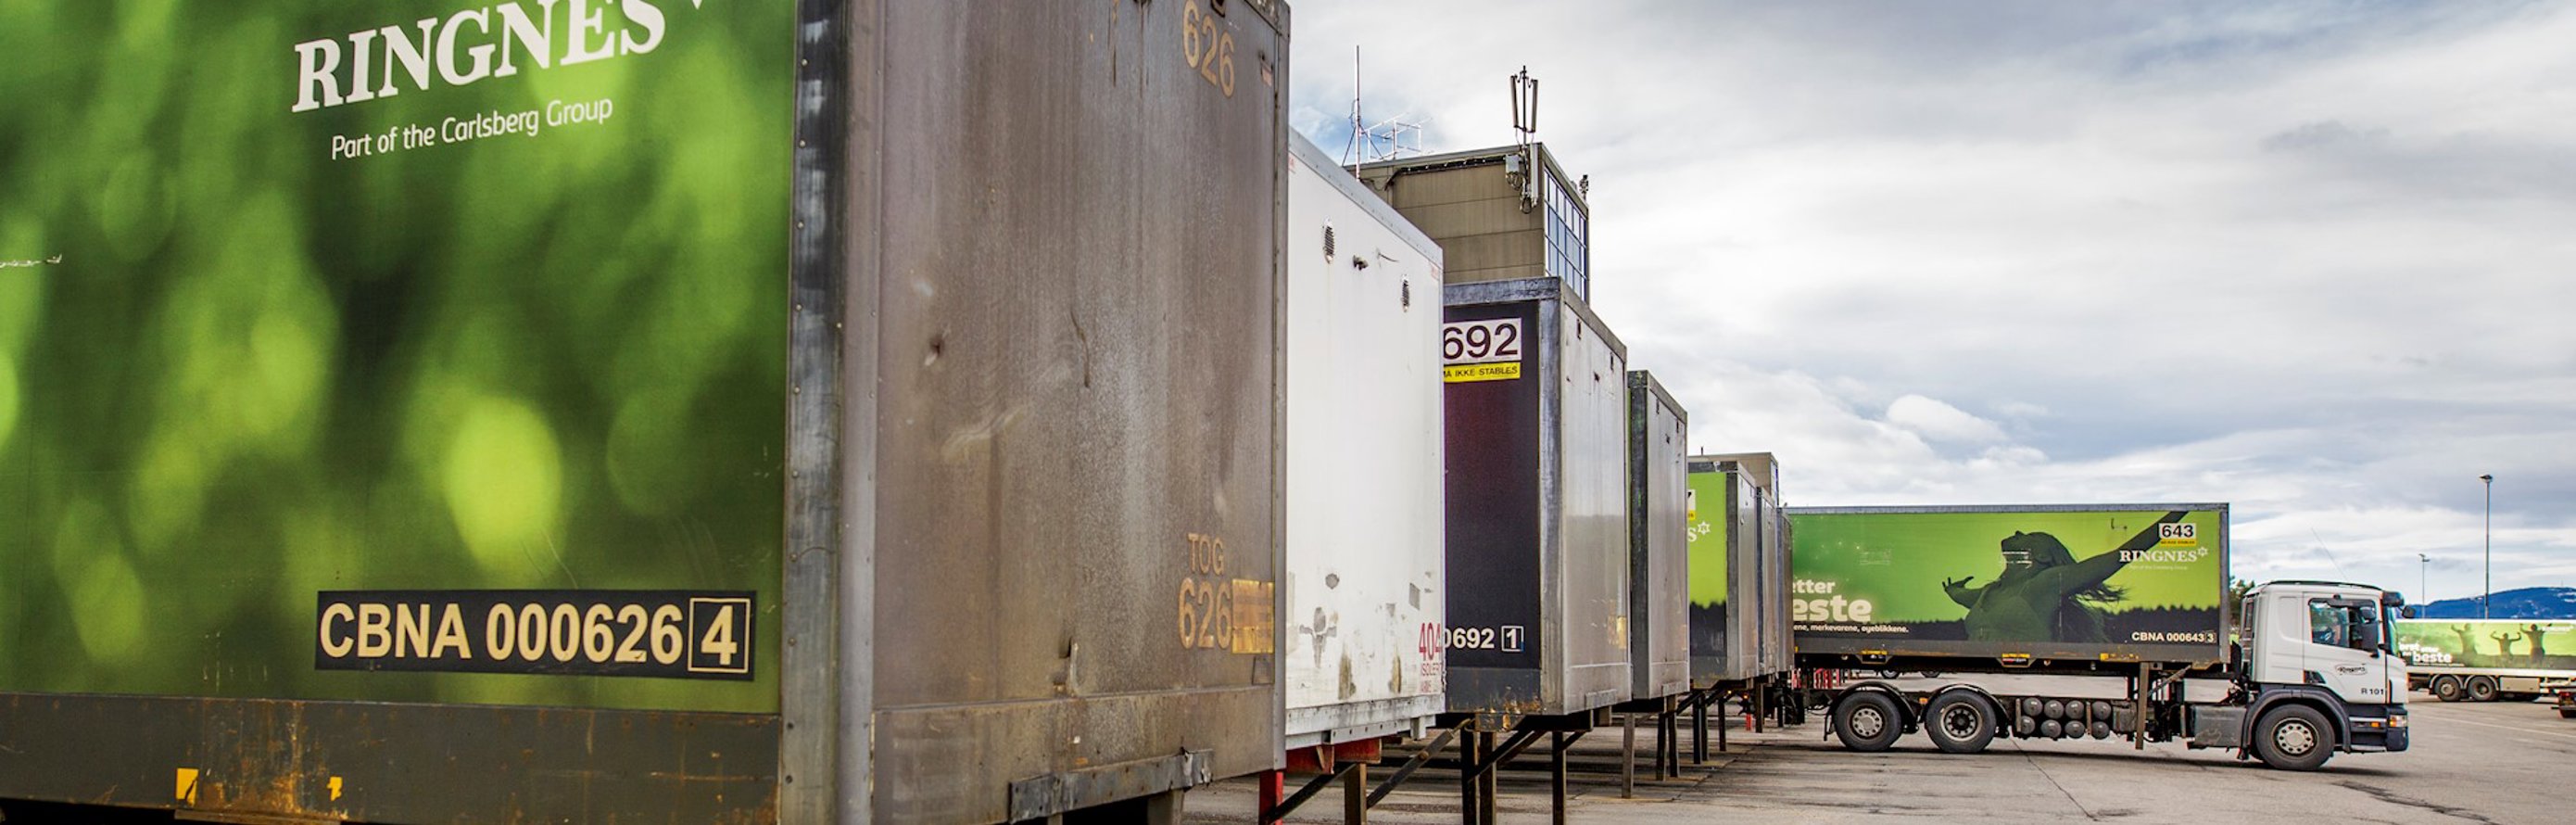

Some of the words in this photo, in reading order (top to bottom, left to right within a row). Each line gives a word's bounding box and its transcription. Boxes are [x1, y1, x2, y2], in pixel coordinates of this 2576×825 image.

[292, 0, 665, 112] RINGNES
[1183, 0, 1234, 98] 626
[331, 133, 373, 160] Part
[377, 126, 398, 153] of
[403, 124, 435, 148] the
[441, 109, 538, 144] Carlsberg
[547, 98, 612, 132] Group
[1444, 324, 1518, 360] 692
[1455, 369, 1475, 377] IKKE
[1479, 366, 1518, 375] STABLES
[2162, 525, 2193, 538] 643
[1188, 533, 1224, 575] TOG
[2119, 550, 2198, 563] RINGNES
[1179, 578, 1231, 649] 626
[320, 603, 472, 659] CBNA
[486, 603, 683, 665] 000626
[701, 605, 738, 666] 4
[1419, 622, 1443, 661] 404
[1506, 628, 1517, 649] 1
[2131, 631, 2165, 641] CBNA
[2166, 632, 2204, 642] 000643
